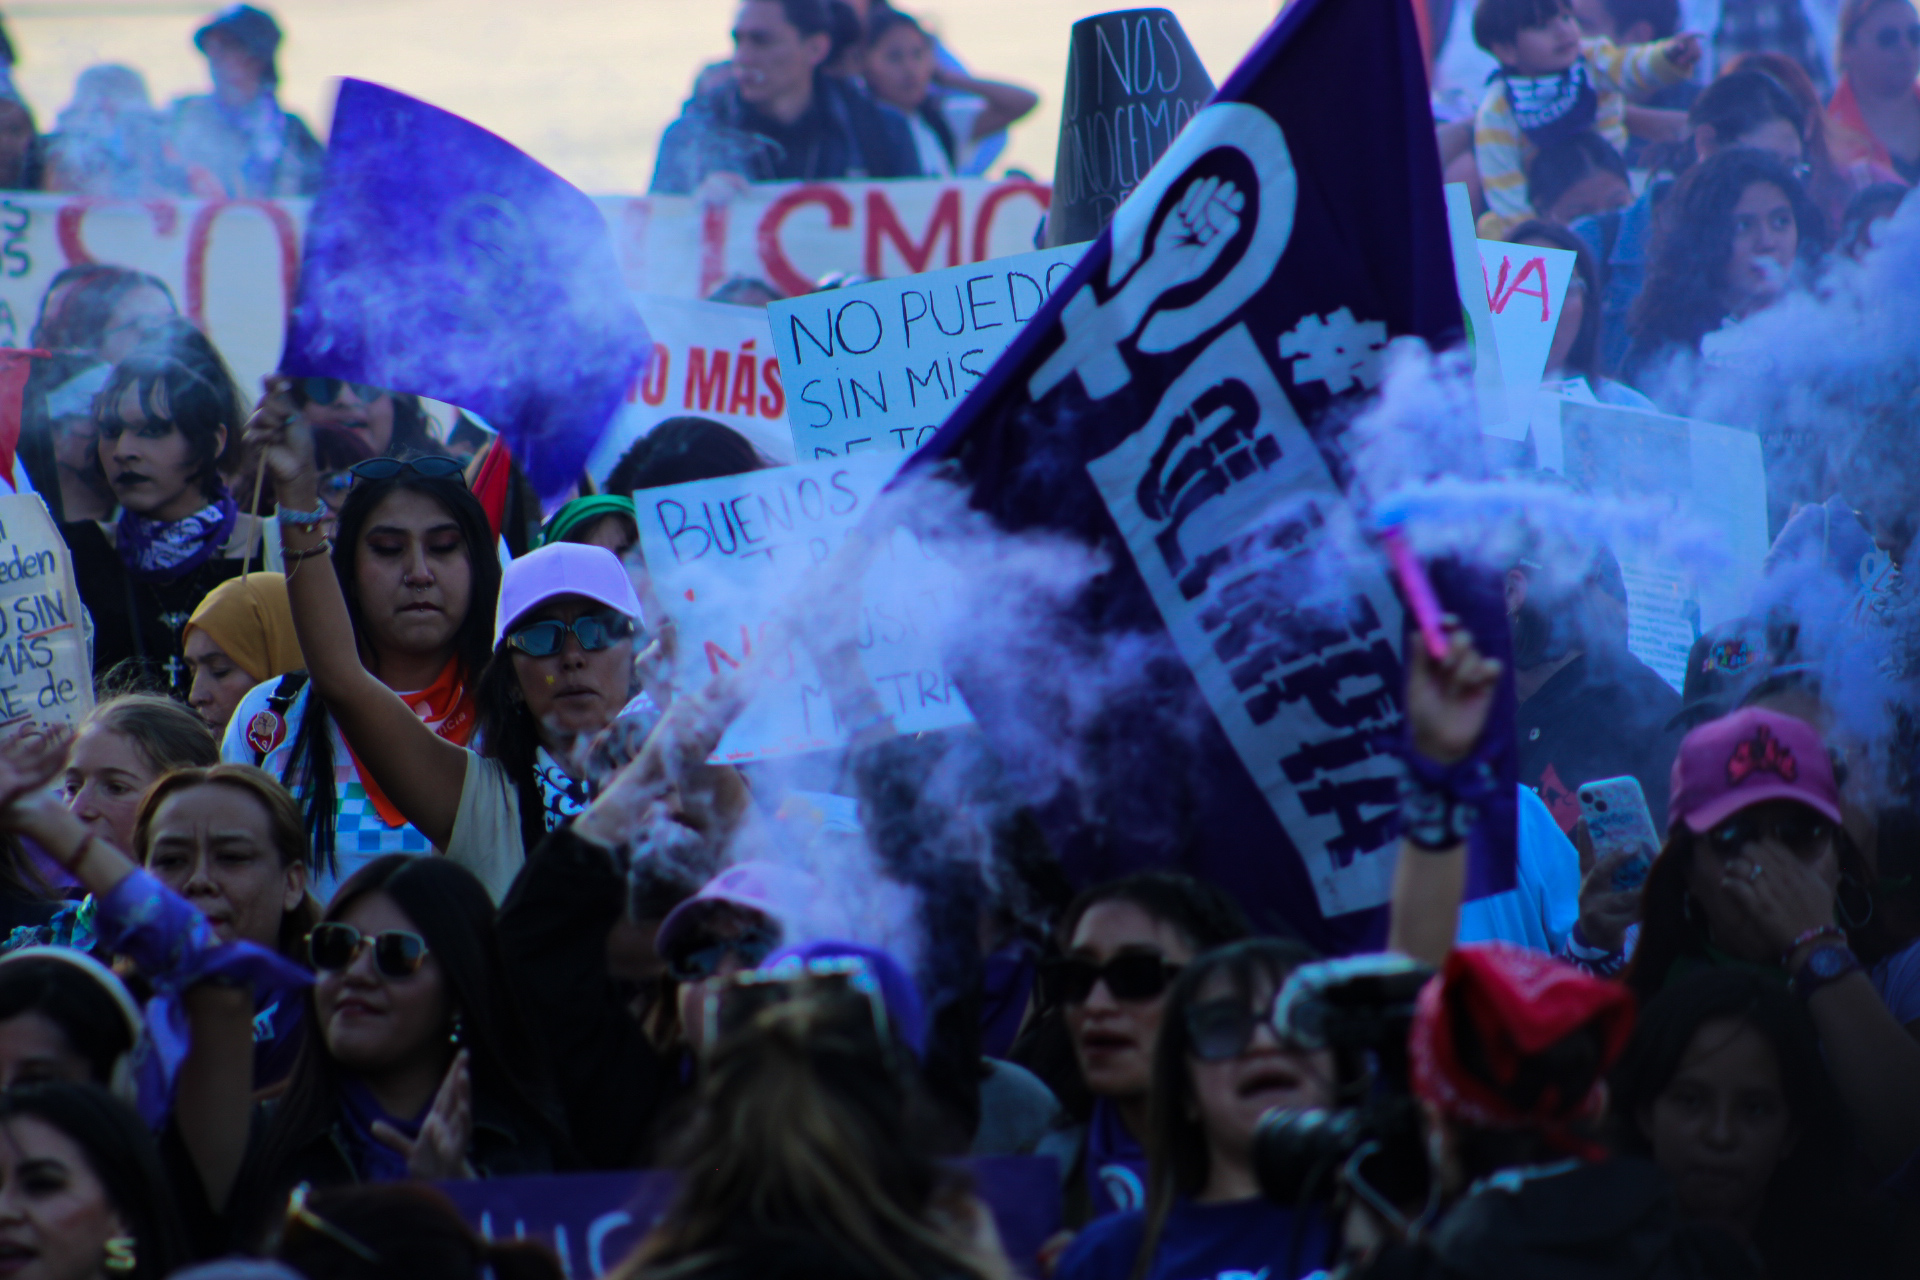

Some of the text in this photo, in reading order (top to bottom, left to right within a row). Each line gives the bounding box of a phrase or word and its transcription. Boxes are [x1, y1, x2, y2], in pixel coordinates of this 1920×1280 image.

[1096, 15, 1181, 103] NOS
[790, 300, 883, 365] NO
[683, 336, 786, 421] MÁS
[656, 470, 859, 565] BUENOS
[14, 588, 68, 634] SIN
[37, 669, 77, 709] de
